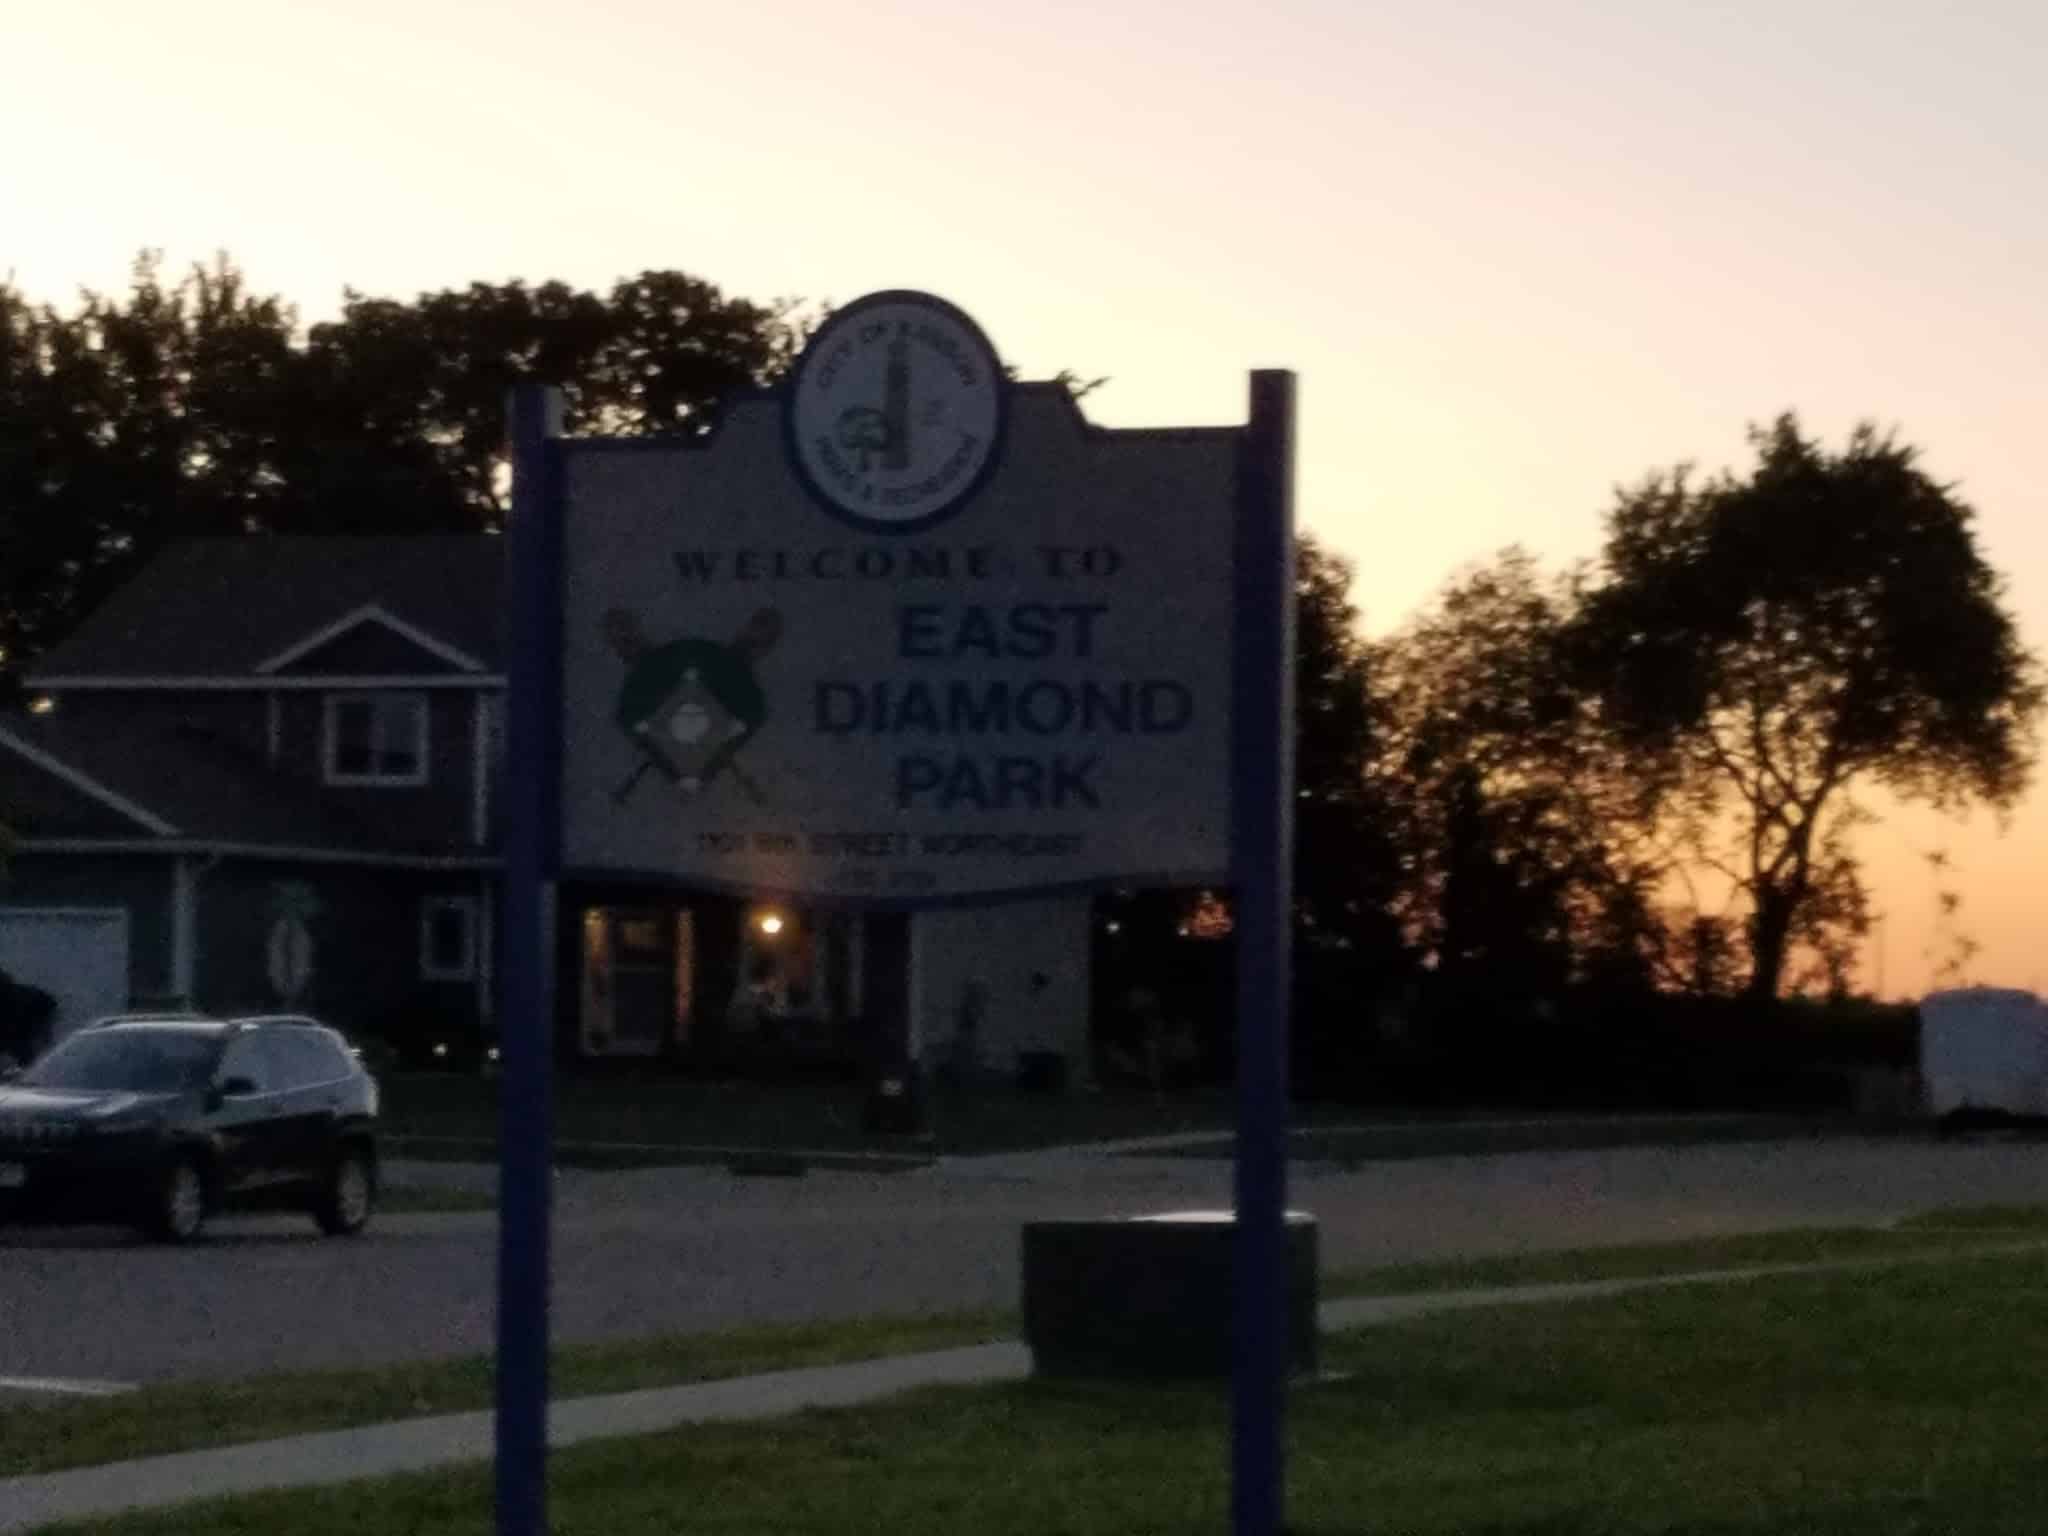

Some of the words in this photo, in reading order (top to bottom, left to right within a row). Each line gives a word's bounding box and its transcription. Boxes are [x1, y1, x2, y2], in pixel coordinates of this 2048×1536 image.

[672, 547, 998, 582] WELCOME
[1037, 545, 1125, 579] TO
[899, 603, 1108, 658] EAST
[814, 680, 1193, 735] DIAMOND
[895, 756, 1101, 809] PARK
